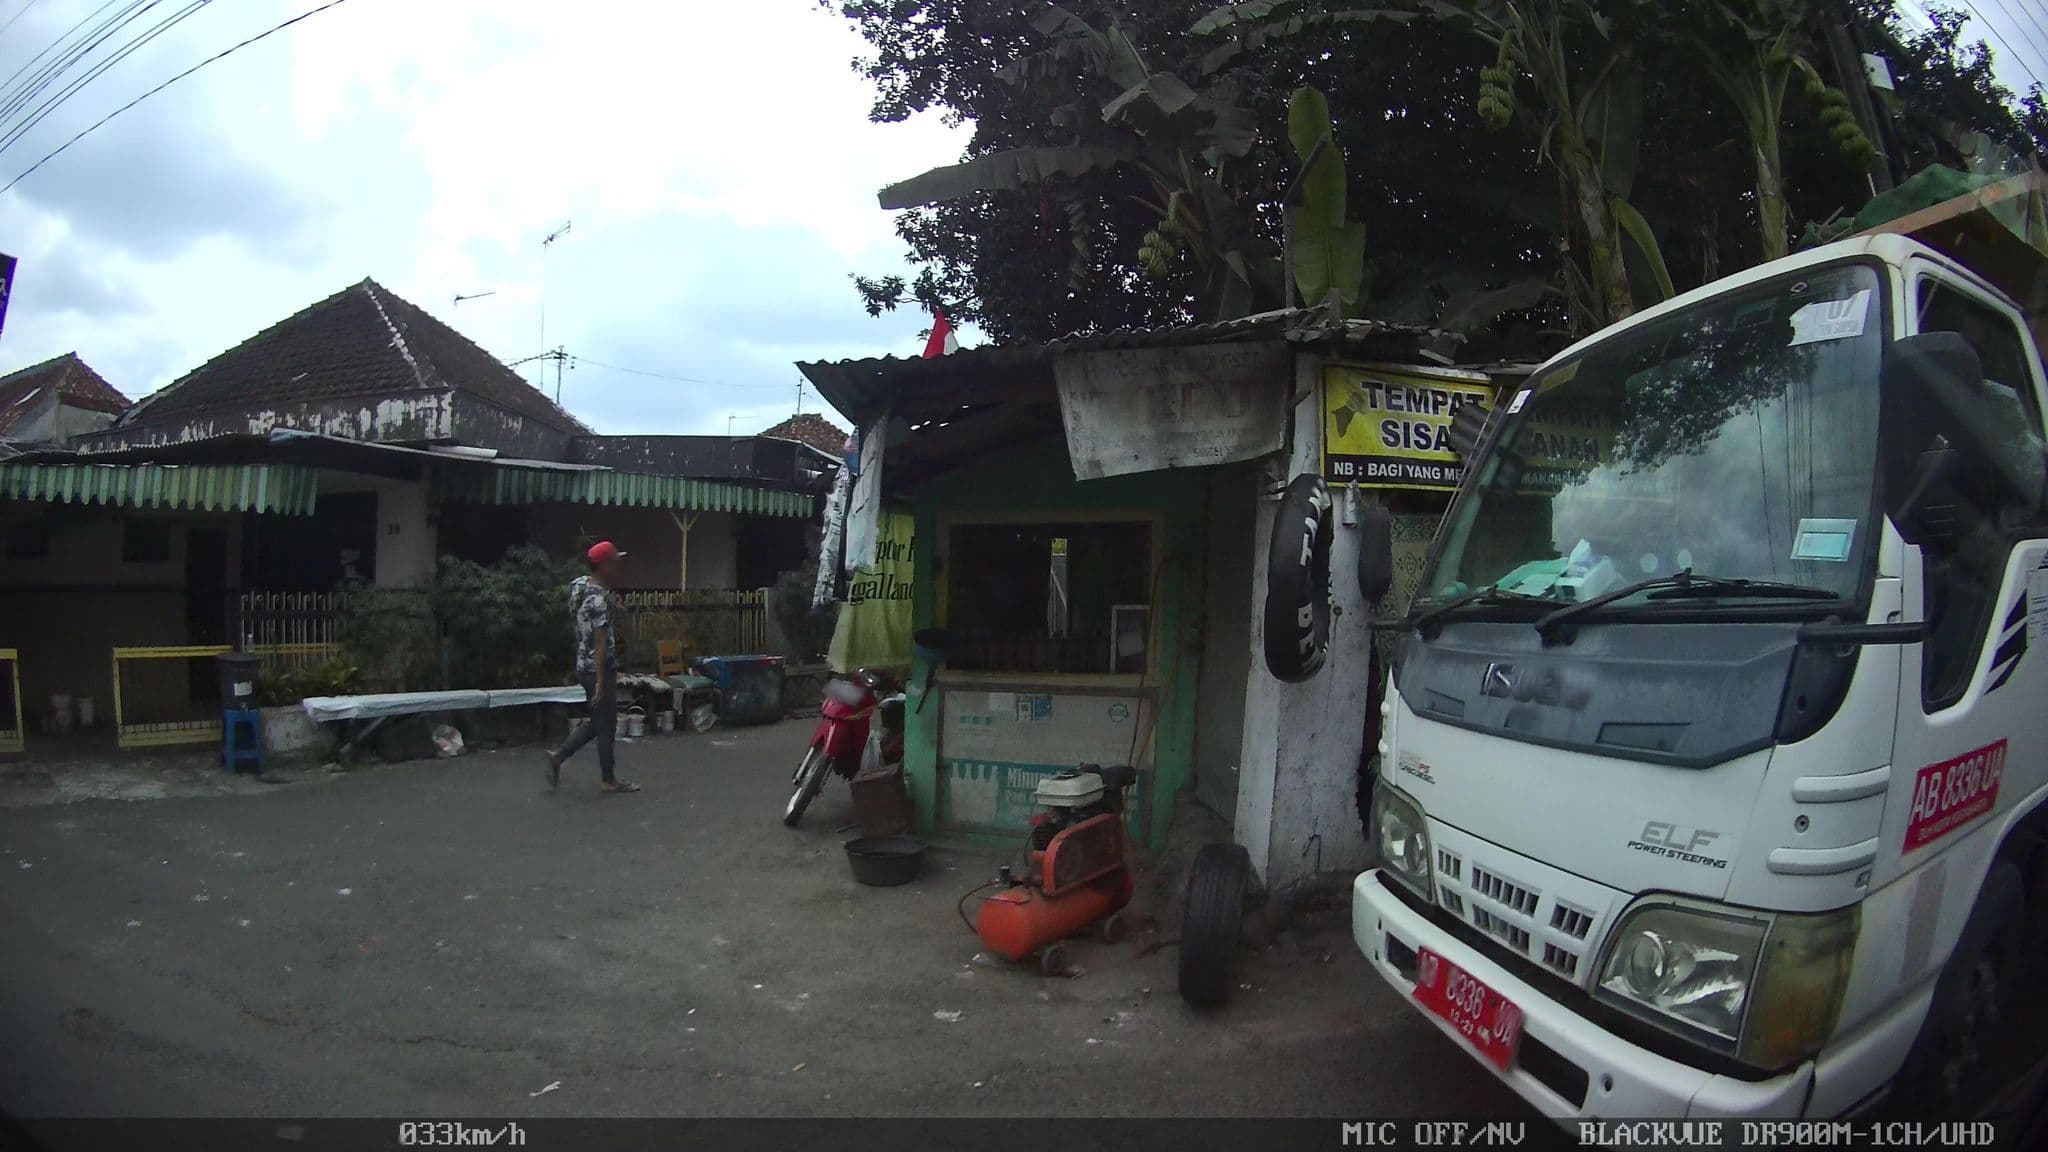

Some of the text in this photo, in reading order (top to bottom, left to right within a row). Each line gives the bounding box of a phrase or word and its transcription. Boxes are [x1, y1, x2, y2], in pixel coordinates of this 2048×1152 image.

[1381, 419, 1456, 452] SISA
[1334, 461, 1354, 476] NB
[1367, 462, 1402, 477] BAGI
[1406, 464, 1441, 480] YANG
[1444, 467, 1462, 481] ME
[1910, 771, 1943, 826] AB
[1941, 754, 1985, 812] 8336
[1641, 821, 1720, 852] ELF
[1627, 840, 1728, 869] POWER STEERING
